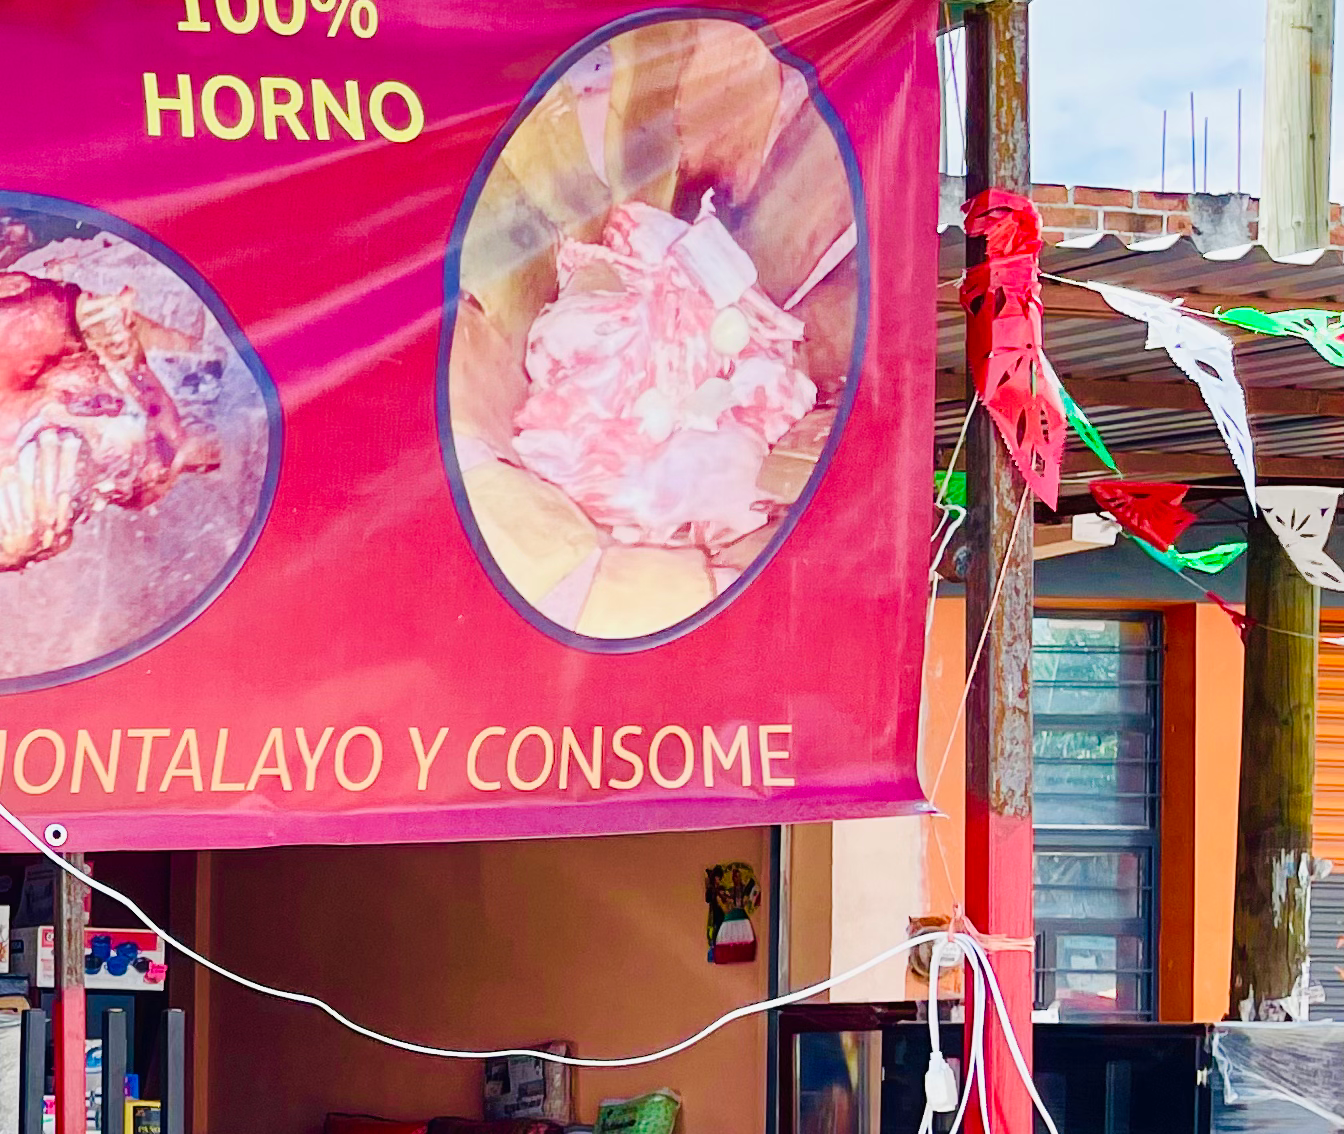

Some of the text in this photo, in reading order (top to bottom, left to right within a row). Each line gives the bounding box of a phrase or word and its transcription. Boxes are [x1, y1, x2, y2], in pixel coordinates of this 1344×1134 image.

[143, 72, 425, 143] HORNO
[408, 725, 450, 791] Y
[465, 723, 796, 791] CONSOME
